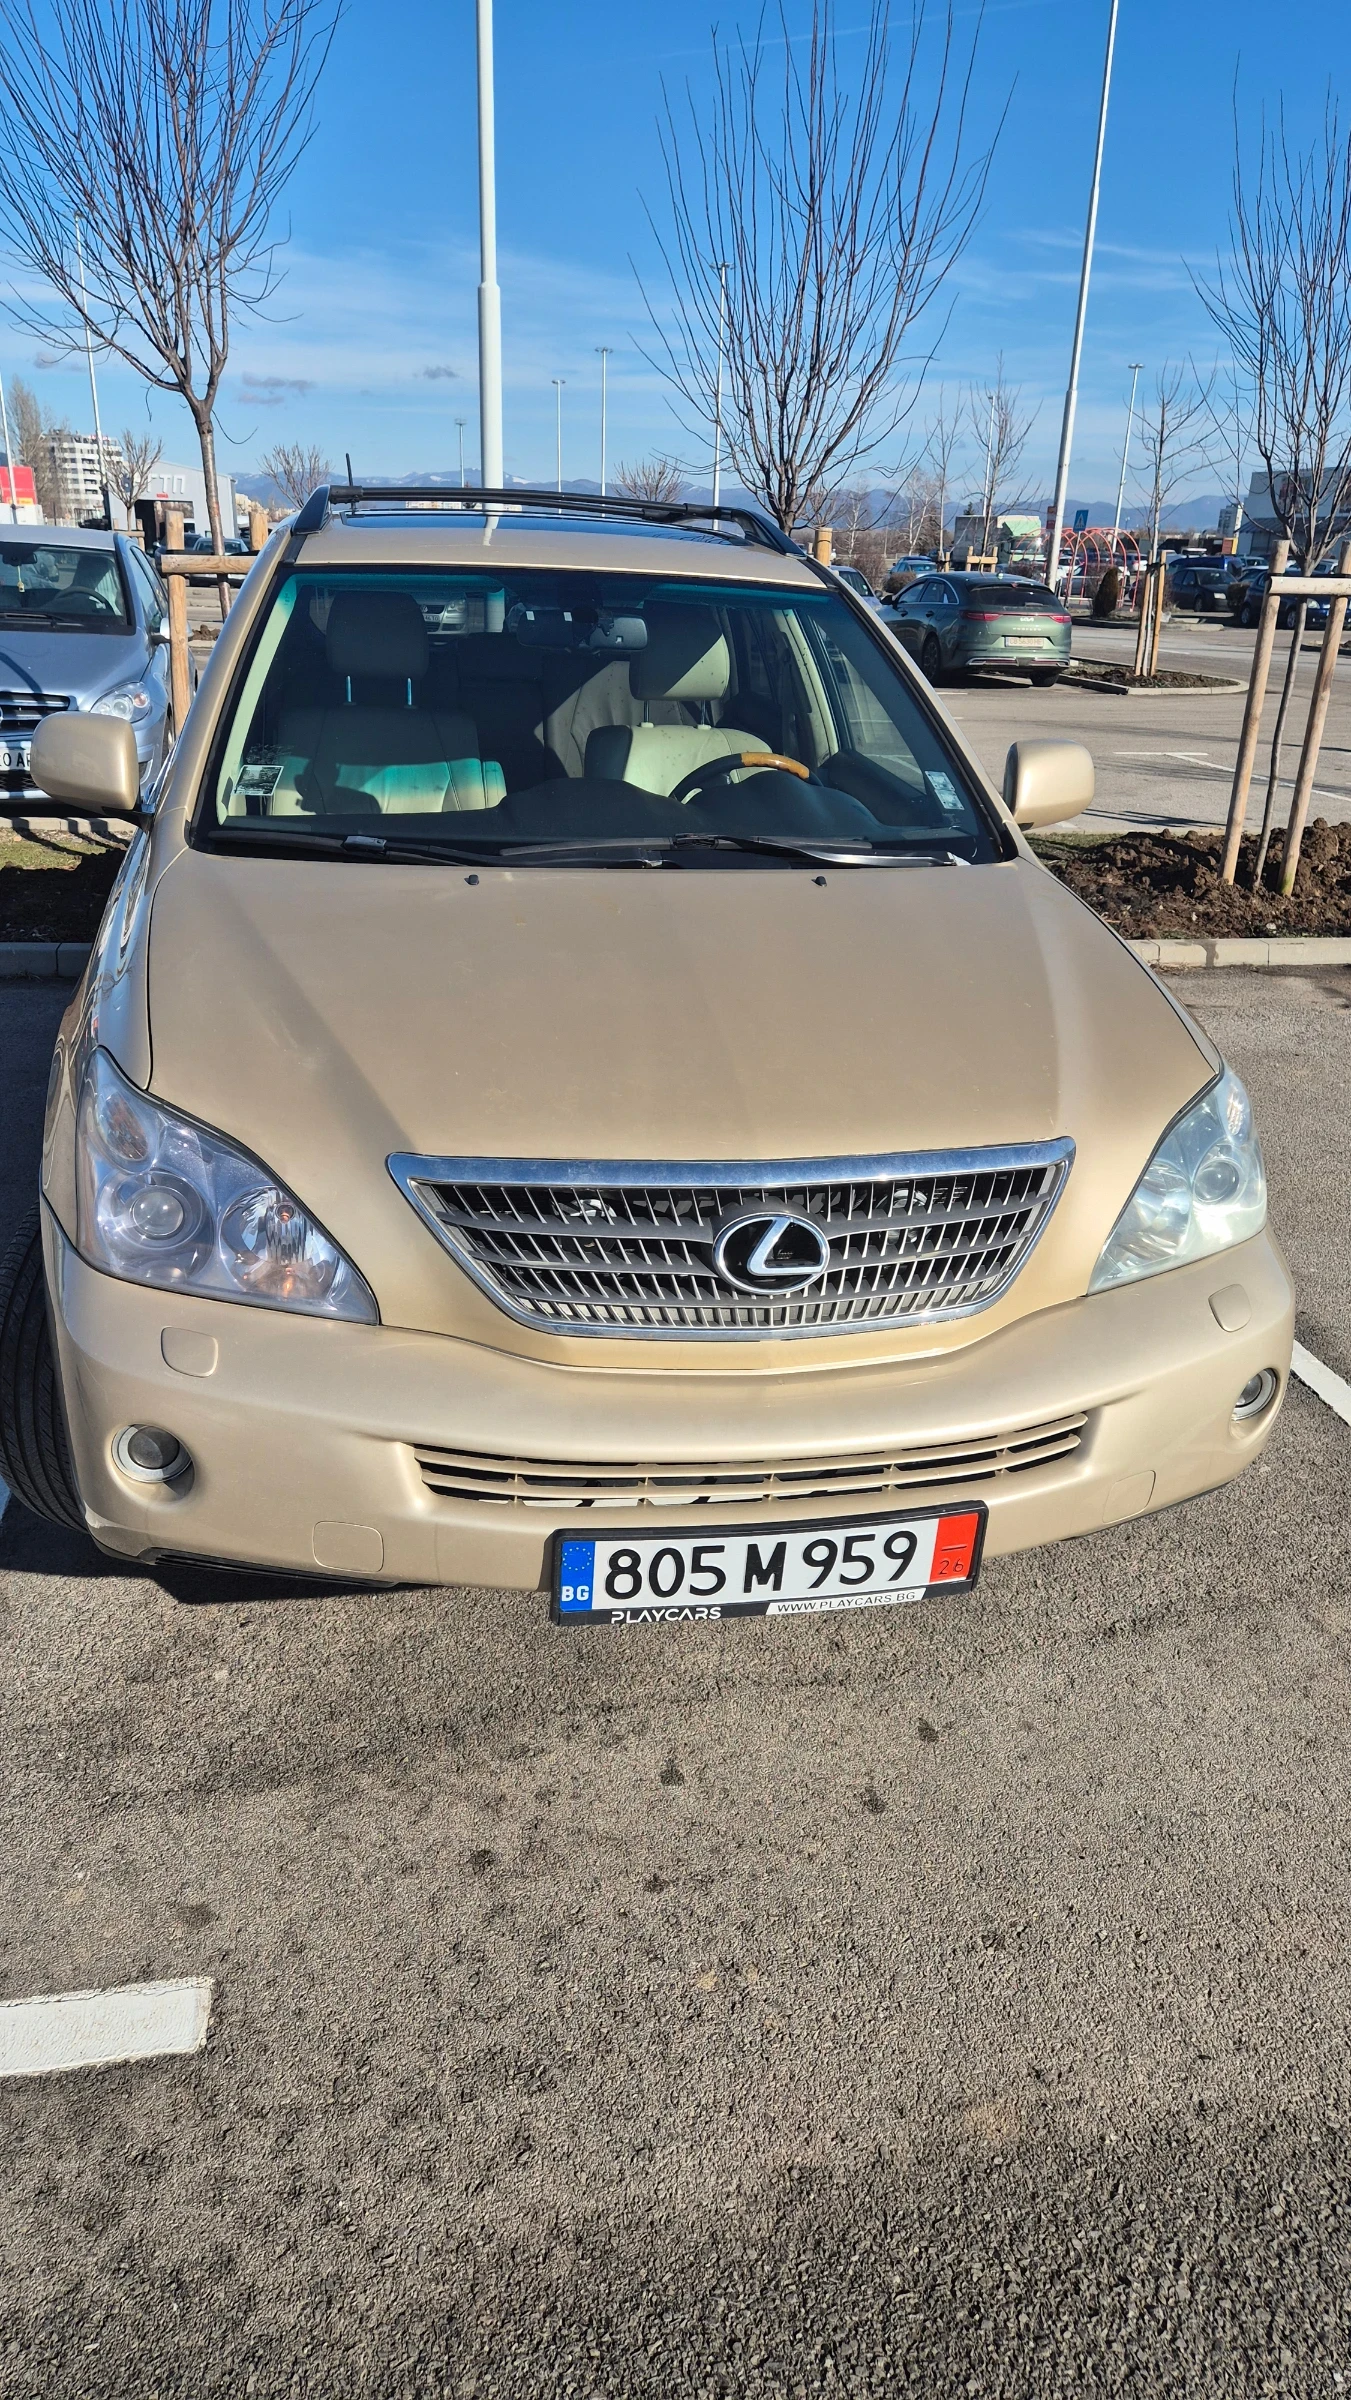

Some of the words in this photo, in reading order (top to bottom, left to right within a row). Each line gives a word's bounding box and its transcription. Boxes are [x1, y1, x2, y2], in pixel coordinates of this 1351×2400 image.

[561, 1585, 590, 1602] BG
[605, 1544, 727, 1600] 805
[743, 1541, 787, 1594] M
[802, 1530, 918, 1590] 959
[938, 1558, 964, 1575] 26
[777, 1592, 916, 1612] WWW.PLAYCARS.BG
[611, 1606, 722, 1624] PLAYCARS
